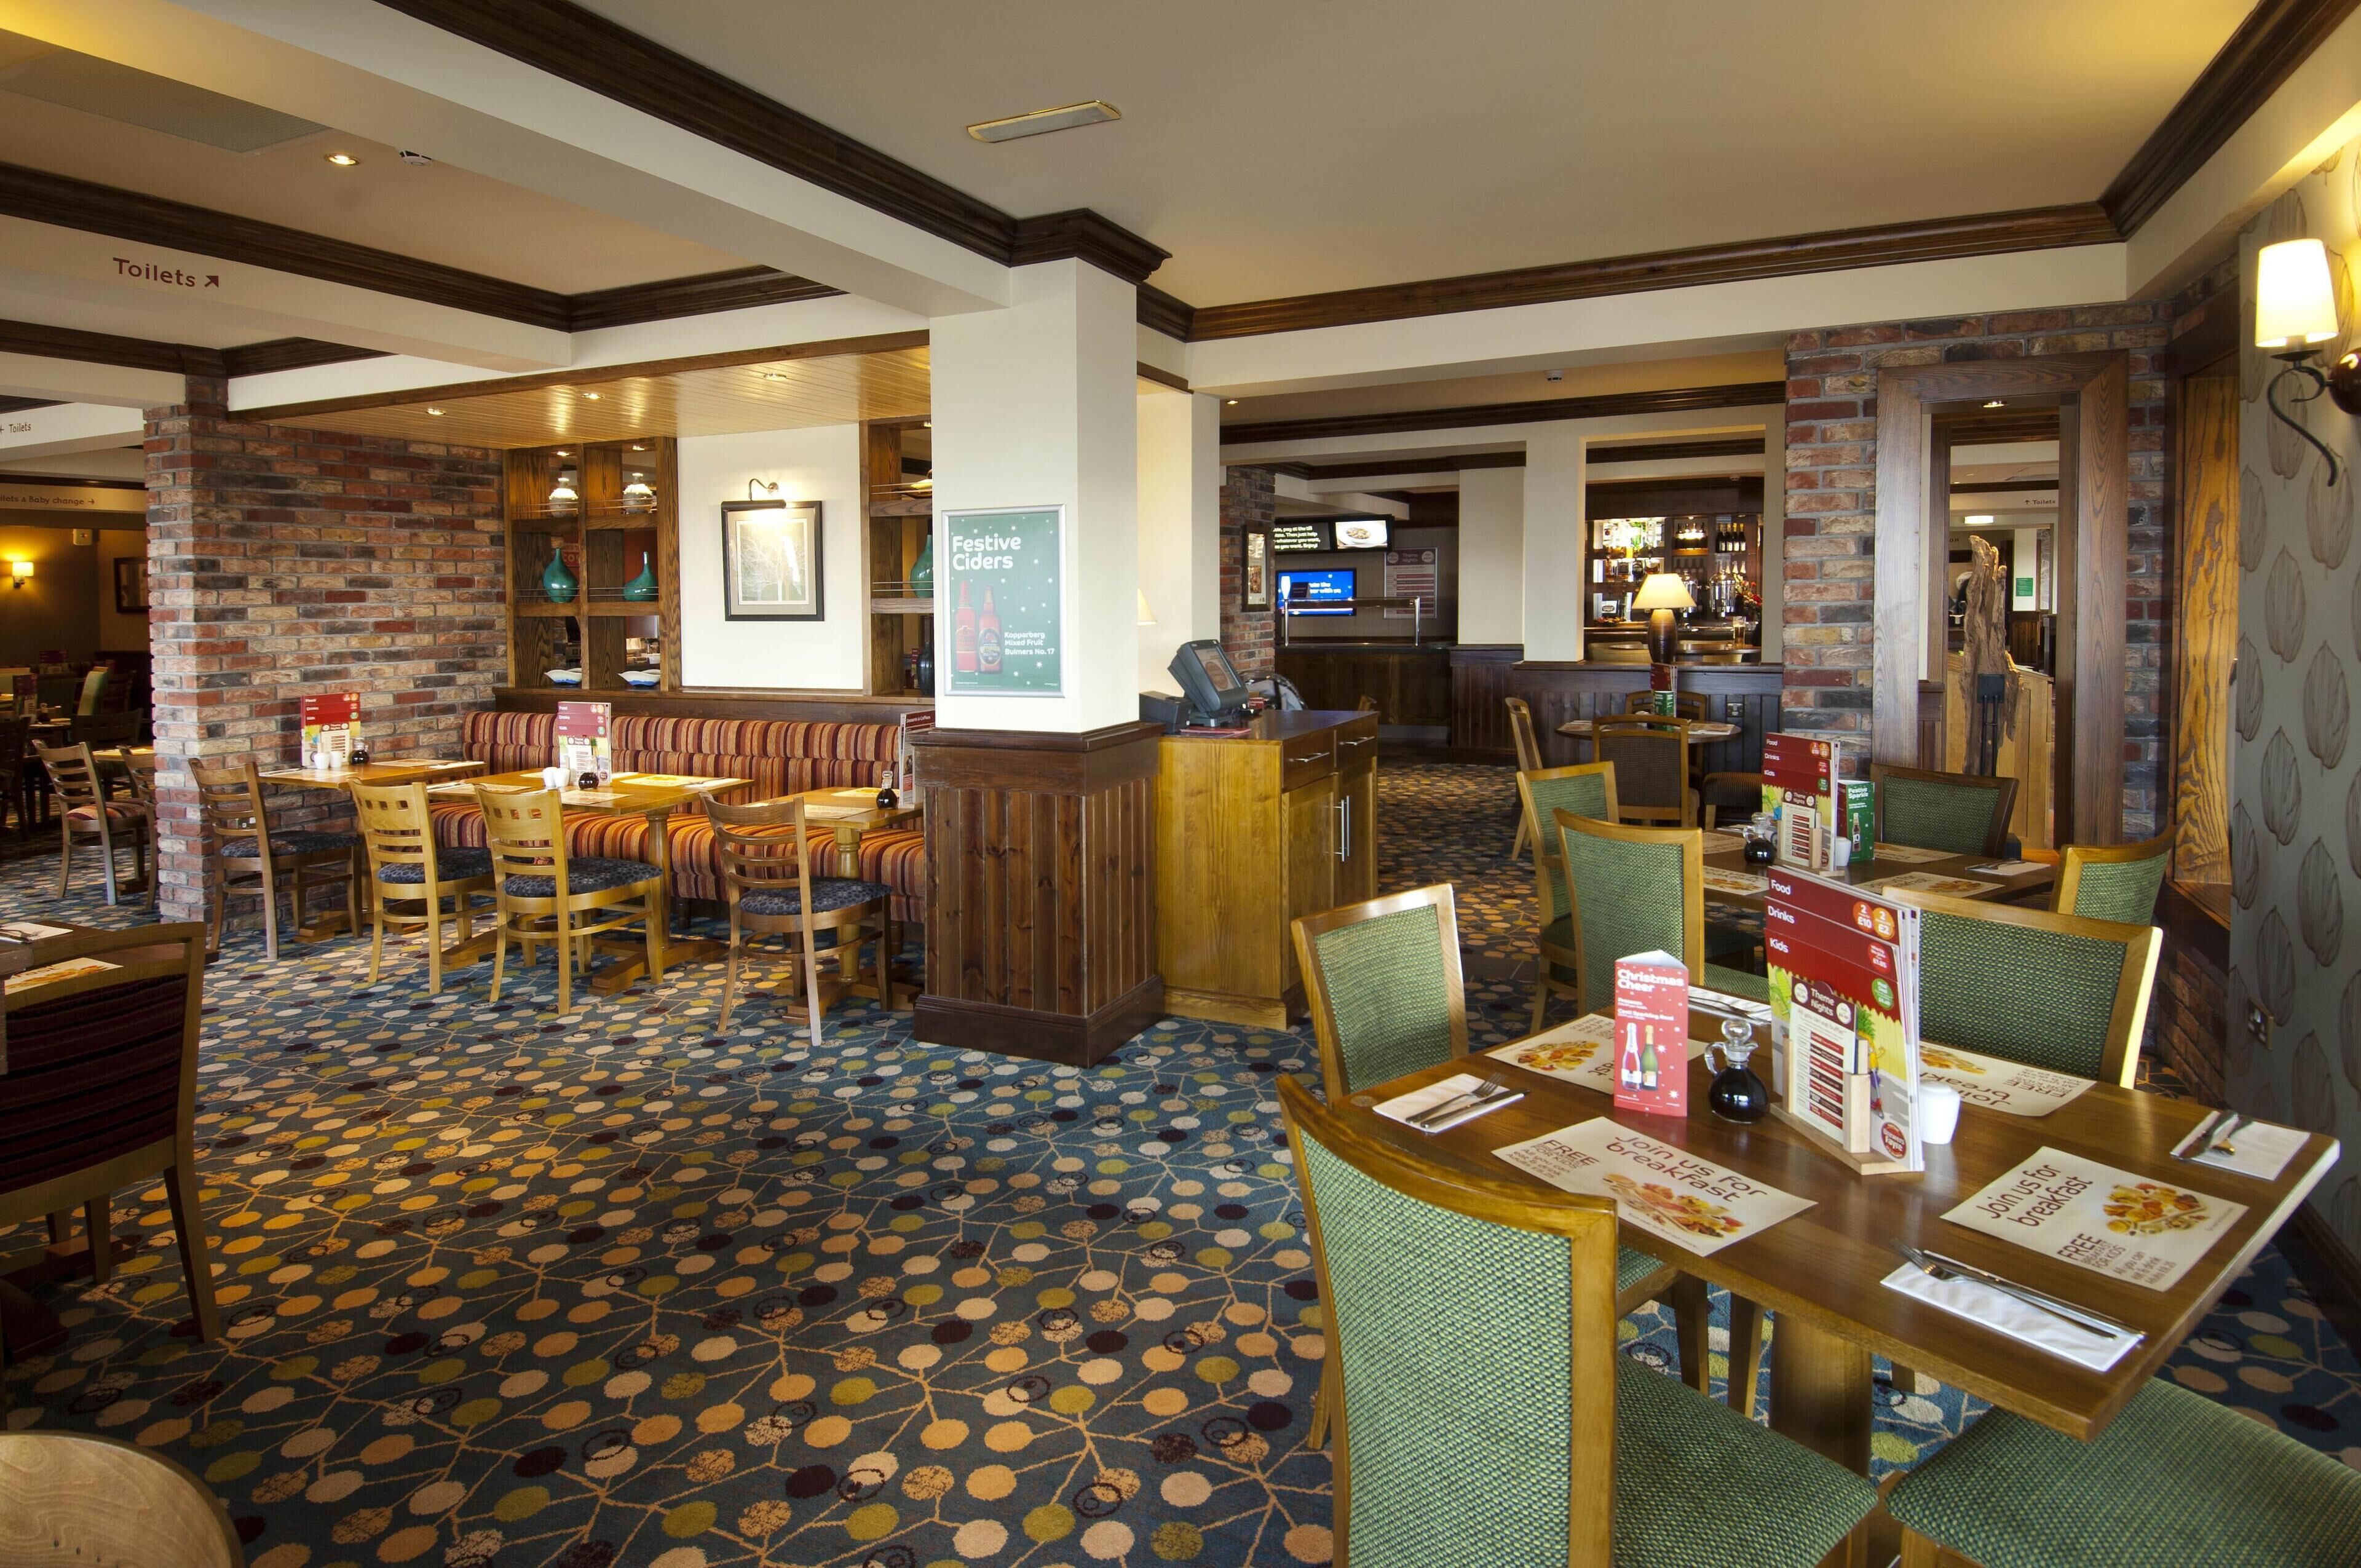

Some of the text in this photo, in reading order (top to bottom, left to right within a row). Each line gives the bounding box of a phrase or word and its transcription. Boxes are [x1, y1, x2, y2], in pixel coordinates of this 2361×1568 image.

[113, 257, 196, 287] Toilets
[9, 422, 31, 434] Toilets
[29, 496, 50, 505] Baby
[53, 497, 84, 506] change
[953, 533, 1021, 552] Festive
[952, 553, 1013, 570] Ciders
[1771, 879, 1792, 896] Food
[1768, 905, 1795, 924] Drinks
[1861, 904, 1867, 914] 2
[1879, 911, 1886, 920] 2
[1857, 916, 1873, 929] £10
[1878, 924, 1889, 935] £2
[1770, 938, 1789, 954] Kids
[1618, 968, 1684, 986] Christmas
[1618, 978, 1655, 992] Cheer
[1811, 988, 1835, 1006] Theme
[1811, 999, 1834, 1016] Nights
[2003, 1079, 2066, 1098] FREE
[1543, 1139, 1600, 1165] FREE
[1606, 1142, 1741, 1202] breakfast
[1615, 1136, 1768, 1196] Join us for
[1975, 1165, 2062, 1219] Join us for
[2006, 1176, 2094, 1227] breakfast
[2057, 1233, 2102, 1261] FREE
[2092, 1257, 2112, 1269] FOR
